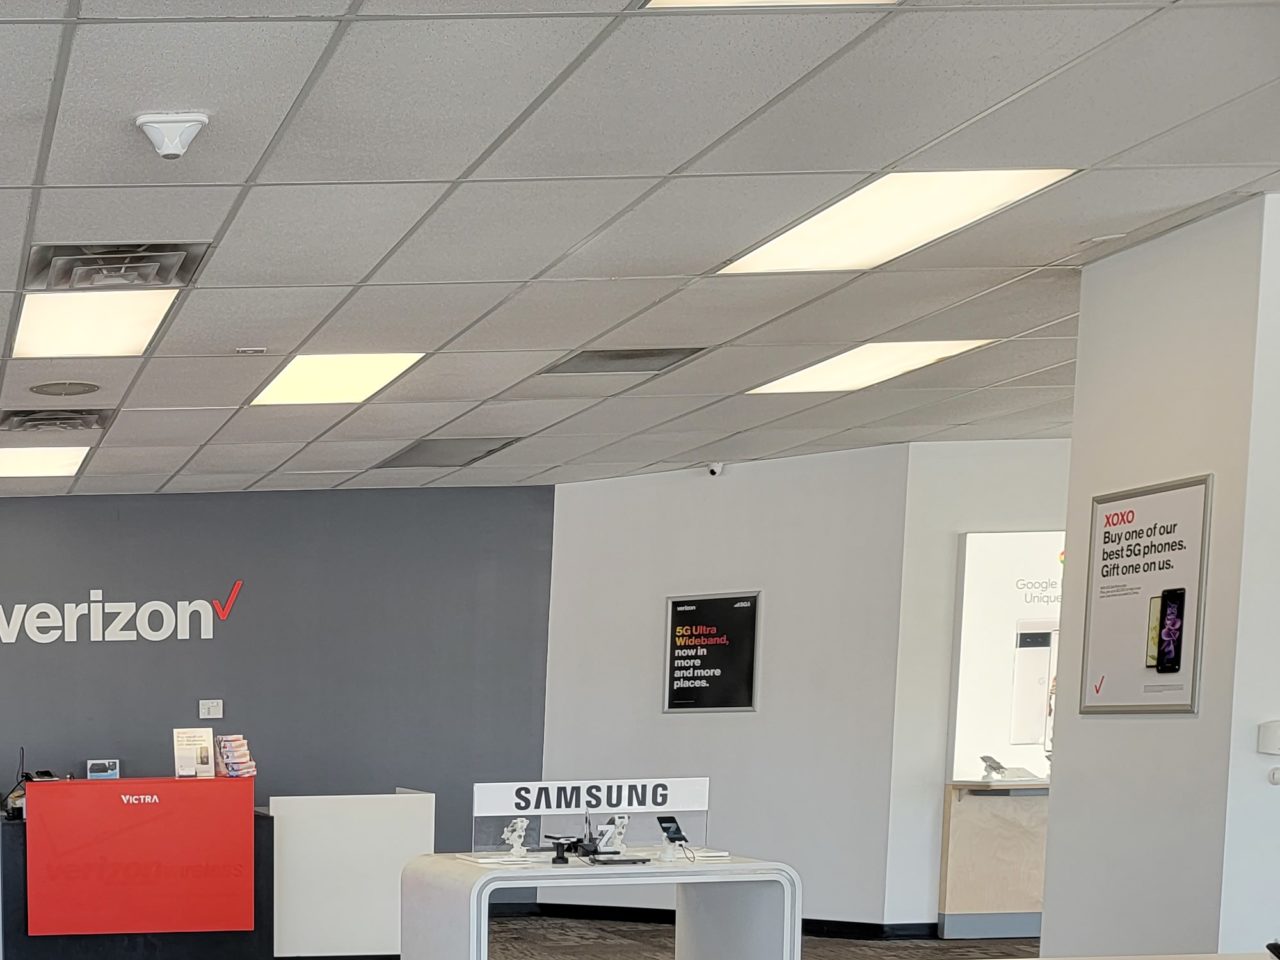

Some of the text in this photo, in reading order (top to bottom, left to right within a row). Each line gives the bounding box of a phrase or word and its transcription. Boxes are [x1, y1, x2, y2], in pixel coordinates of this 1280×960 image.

[1104, 510, 1135, 528] XOXO
[1103, 522, 1178, 545] Buy one of our
[1102, 540, 1186, 561] best 5G phones.
[1101, 559, 1174, 578] Gift one on us.
[1015, 578, 1058, 592] Google
[675, 625, 717, 635] 5G Ultra
[675, 635, 729, 646] Wideband,
[697, 646, 707, 656] in
[674, 659, 701, 667] more
[674, 668, 721, 678] and more
[673, 679, 710, 690] places.
[120, 794, 160, 804] VICTRA
[514, 783, 669, 811] SAMSUNG
